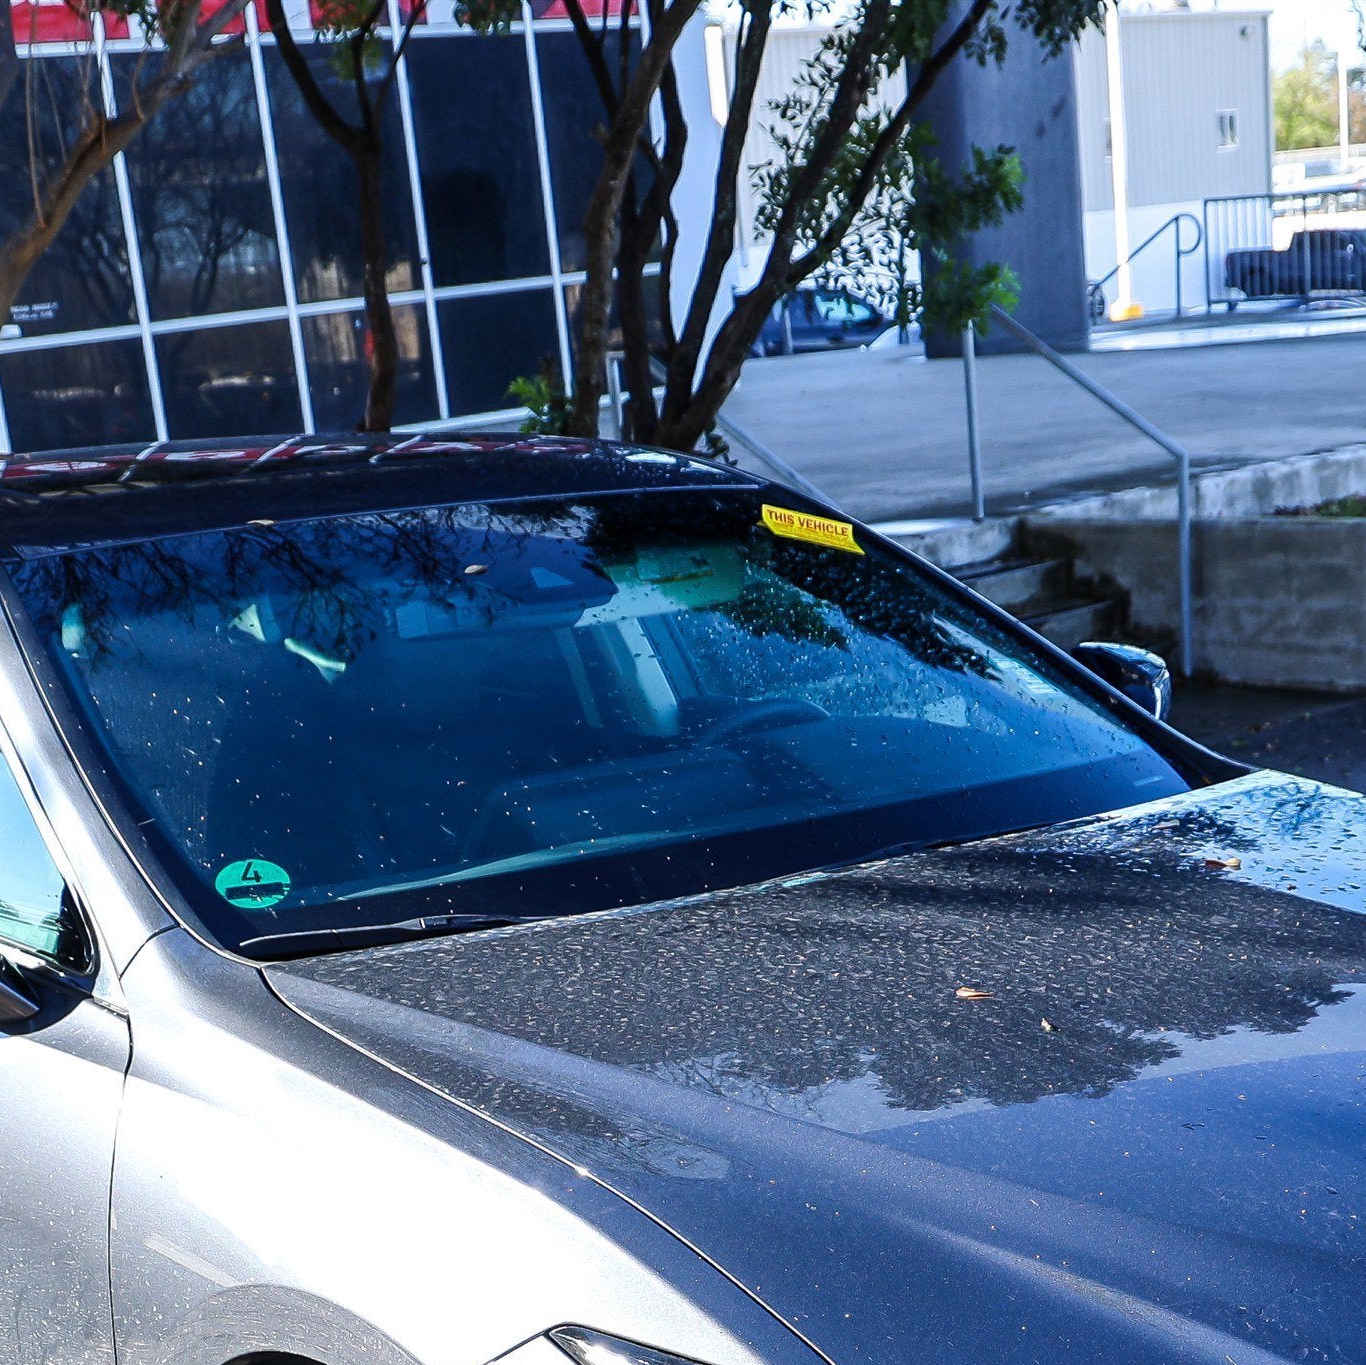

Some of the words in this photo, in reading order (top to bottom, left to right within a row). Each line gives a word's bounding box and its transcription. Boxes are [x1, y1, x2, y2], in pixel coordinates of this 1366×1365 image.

[768, 509, 794, 525] THIS
[799, 515, 849, 536] VEHICLE
[241, 861, 262, 882] 4
